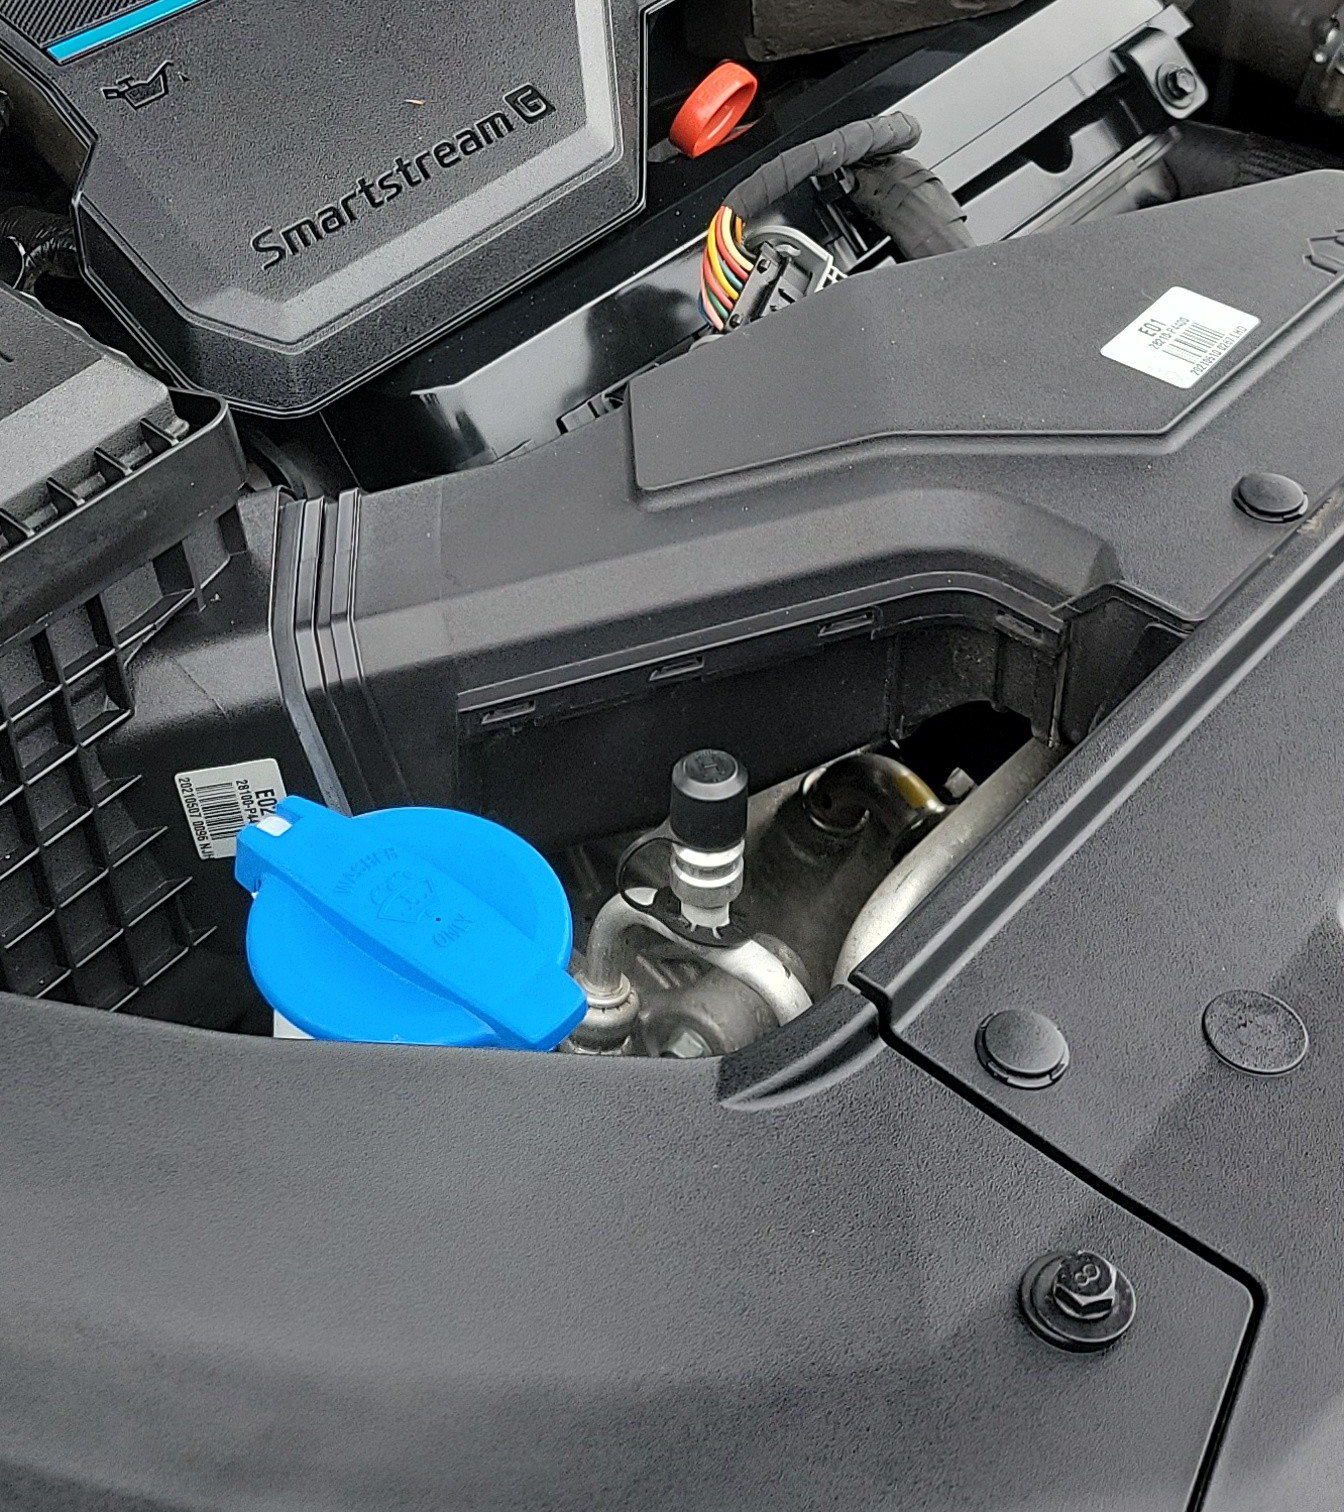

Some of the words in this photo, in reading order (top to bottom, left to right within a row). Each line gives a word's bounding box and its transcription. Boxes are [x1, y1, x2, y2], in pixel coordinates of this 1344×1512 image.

[250, 109, 515, 271] Smartstream
[509, 85, 552, 120] G
[1138, 318, 1167, 337] E01
[178, 777, 202, 818] 20210507
[192, 820, 209, 842] 0096
